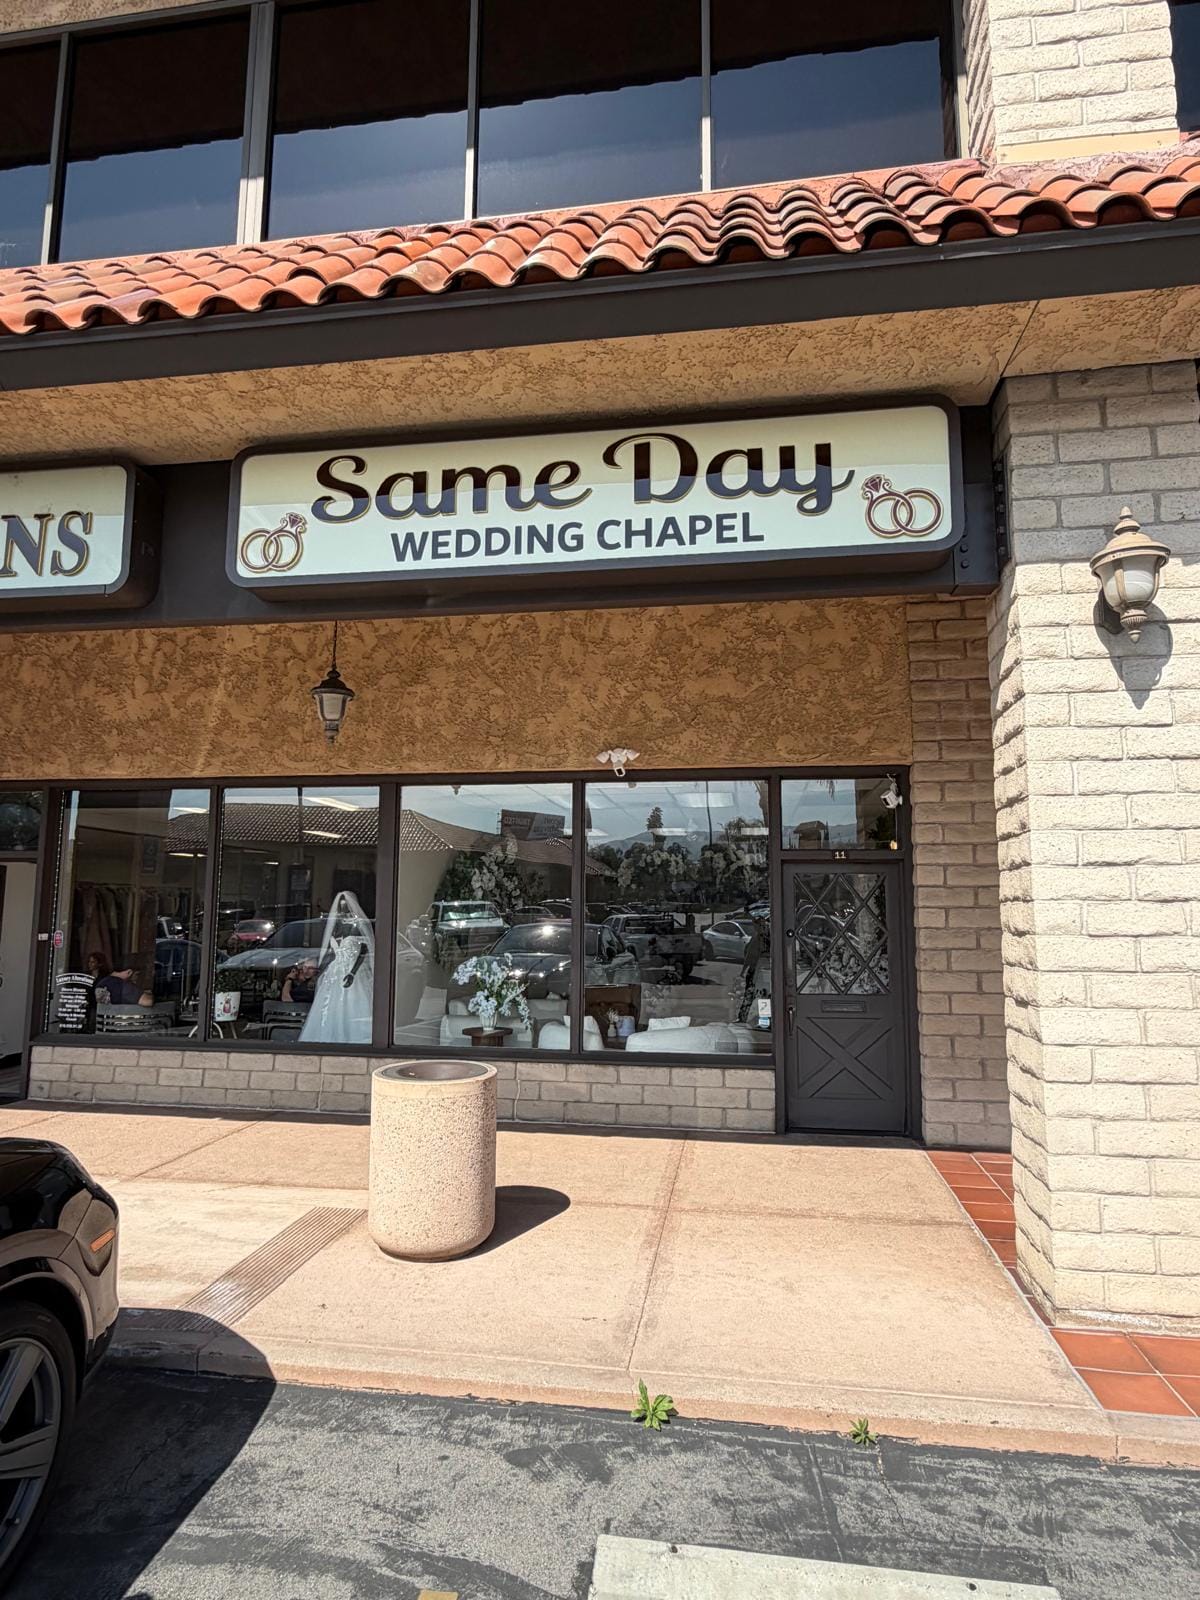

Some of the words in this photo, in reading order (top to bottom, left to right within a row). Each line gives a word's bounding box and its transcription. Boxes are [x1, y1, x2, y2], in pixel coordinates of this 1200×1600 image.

[311, 455, 593, 524] Same
[602, 432, 856, 516] Day
[390, 521, 584, 562] WEDDING
[597, 512, 764, 550] CHAPEL
[834, 851, 847, 859] 11
